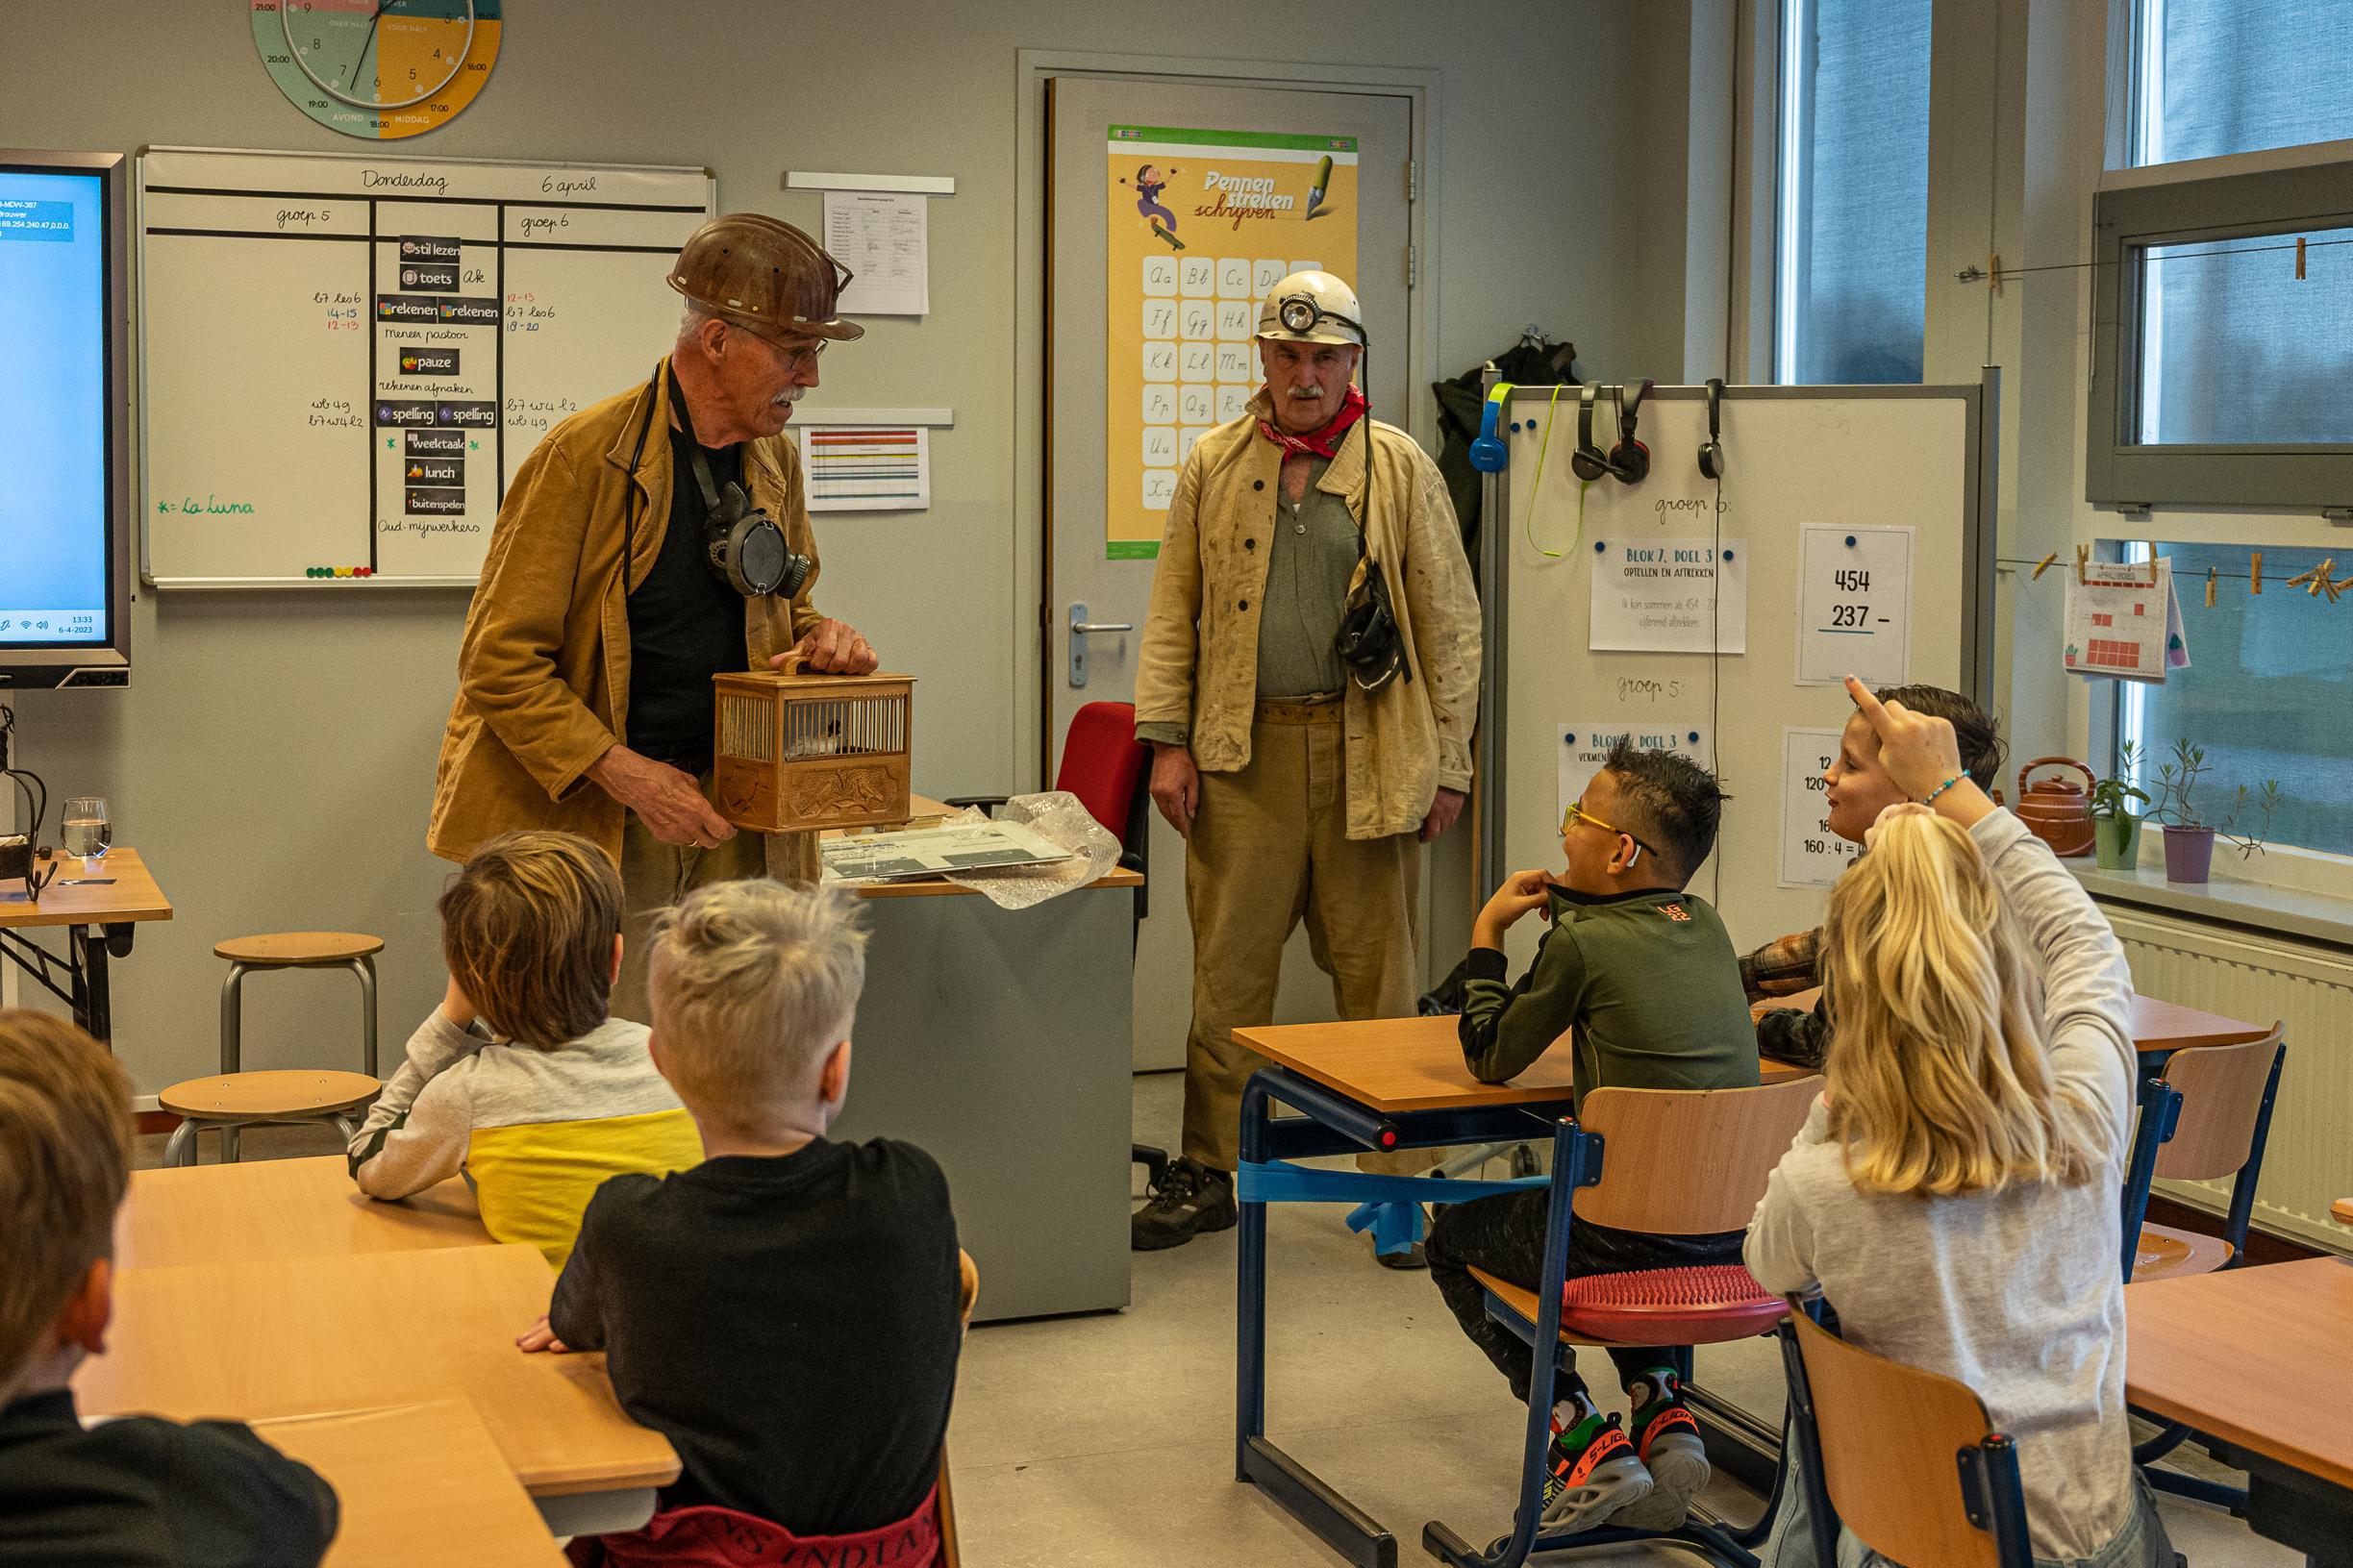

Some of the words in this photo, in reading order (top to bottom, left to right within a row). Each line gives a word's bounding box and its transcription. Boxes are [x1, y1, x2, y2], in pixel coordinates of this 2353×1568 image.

[304, 3, 312, 14] 9
[313, 38, 320, 49] 8
[434, 49, 440, 59] 4
[341, 65, 347, 76] 7
[410, 69, 416, 80] 5
[374, 77, 381, 87] 6
[333, 113, 363, 122] AVOND
[394, 115, 430, 124] MIDDAG
[362, 170, 449, 194] Donderdag
[541, 176, 552, 192] 6
[557, 176, 597, 197] april
[1204, 170, 1275, 193] Pennen
[1227, 191, 1294, 210] streken
[276, 209, 316, 229] groep
[321, 211, 331, 222] 5
[521, 216, 558, 236] groep
[560, 213, 569, 227] 6
[415, 243, 432, 256] stil
[434, 244, 461, 257] lezen
[419, 272, 452, 285] toets
[391, 302, 438, 316] rekenen
[452, 304, 498, 318] rekenen
[425, 328, 468, 344] pastoor
[417, 357, 451, 371] pauze
[379, 380, 423, 392] rekenen
[424, 382, 474, 398] afmaken
[392, 406, 435, 423] spelling
[453, 407, 494, 425] spelling
[413, 438, 465, 450] weektaak
[425, 465, 456, 479] lunch
[182, 497, 204, 513] La
[207, 493, 255, 513] Luna
[412, 497, 465, 511] buitenspelen
[1655, 498, 1709, 525] groep
[1626, 548, 1655, 562] BLOK
[1674, 549, 1701, 563] DOEL
[1705, 549, 1713, 563] 3
[1623, 567, 1658, 578] OPTELLEN
[1662, 568, 1671, 578] EN
[1673, 568, 1715, 578] AFTREKKEN
[1835, 569, 1870, 592] 454
[1644, 601, 1673, 610] sommen
[1832, 604, 1869, 627] 237
[1616, 676, 1662, 702] groep
[1640, 734, 1665, 749] DOEL
[1668, 734, 1677, 749] 3
[1805, 776, 1825, 790] 120
[1804, 839, 1825, 854] 160
[1835, 841, 1842, 855] 4
